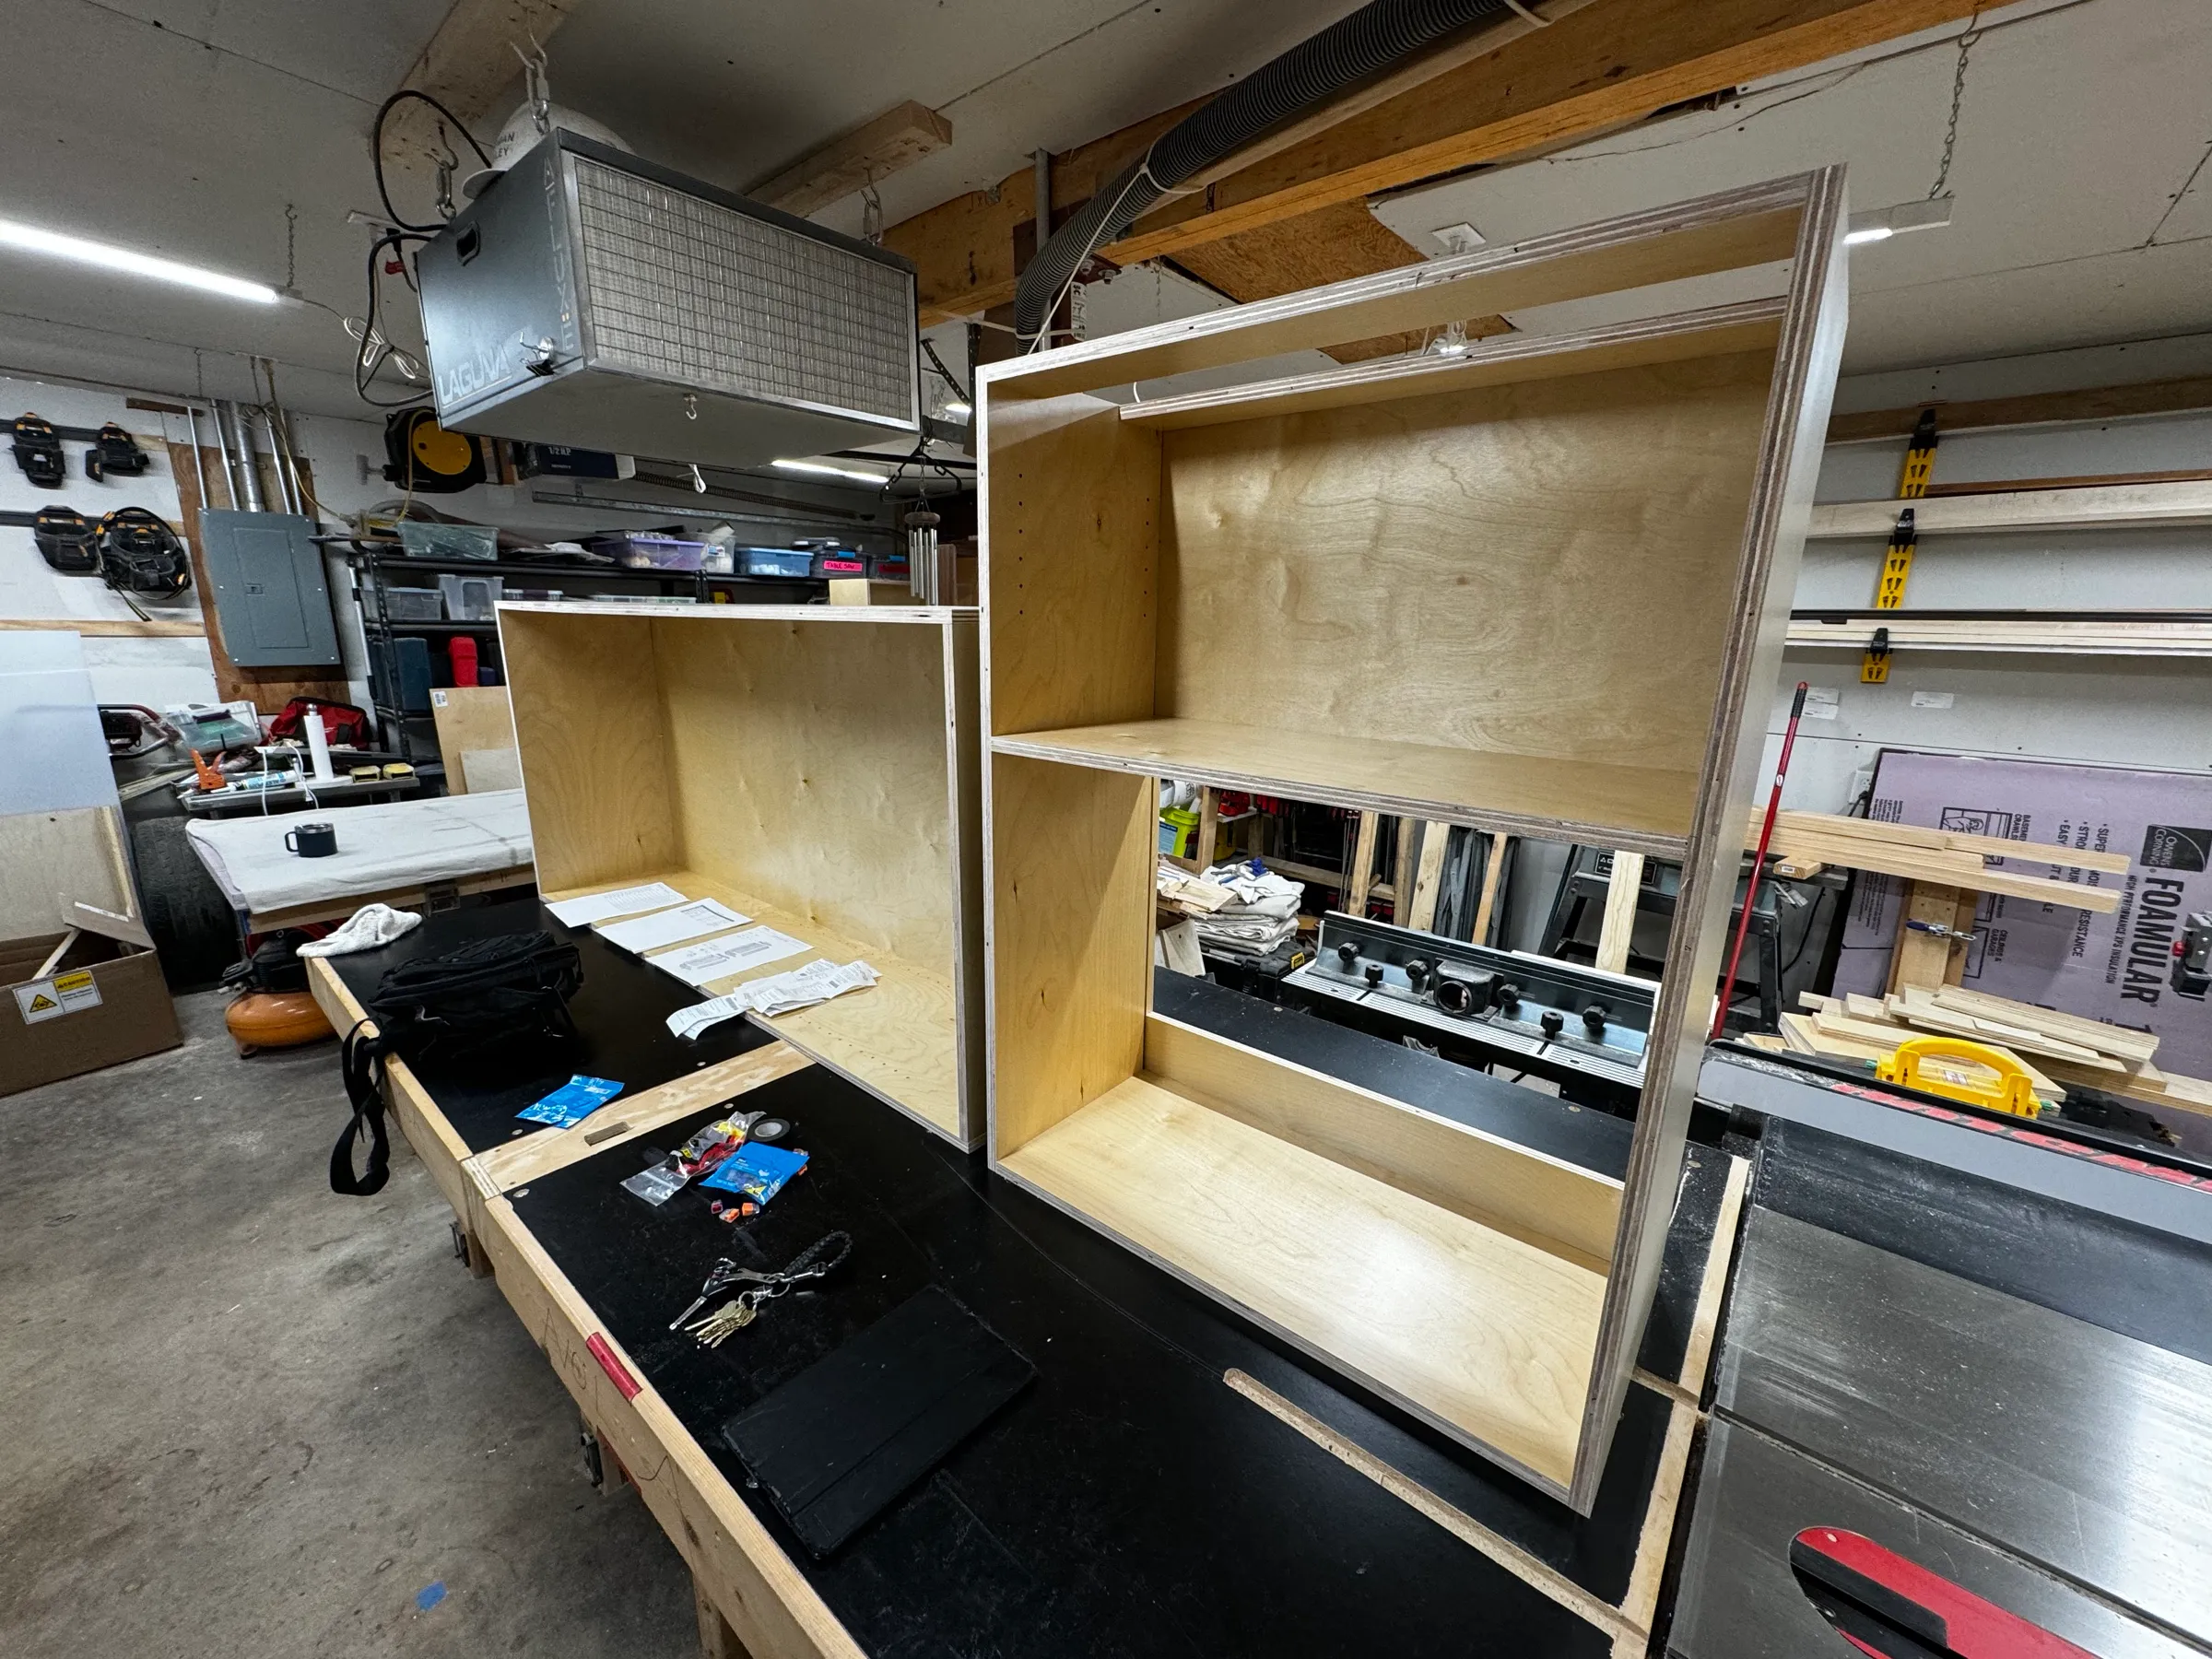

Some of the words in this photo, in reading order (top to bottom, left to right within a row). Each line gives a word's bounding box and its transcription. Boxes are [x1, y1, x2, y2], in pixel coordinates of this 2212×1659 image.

[2056, 820, 2071, 845] EASY
[2149, 829, 2167, 865] CORNING
[2160, 836, 2179, 866] OWENS
[2124, 875, 2137, 890] HIGH
[2115, 891, 2135, 935] PERFORMANCE
[2072, 909, 2092, 958] RESISTANCE
[2112, 935, 2124, 948] XPS
[2104, 948, 2122, 985] INSULATION
